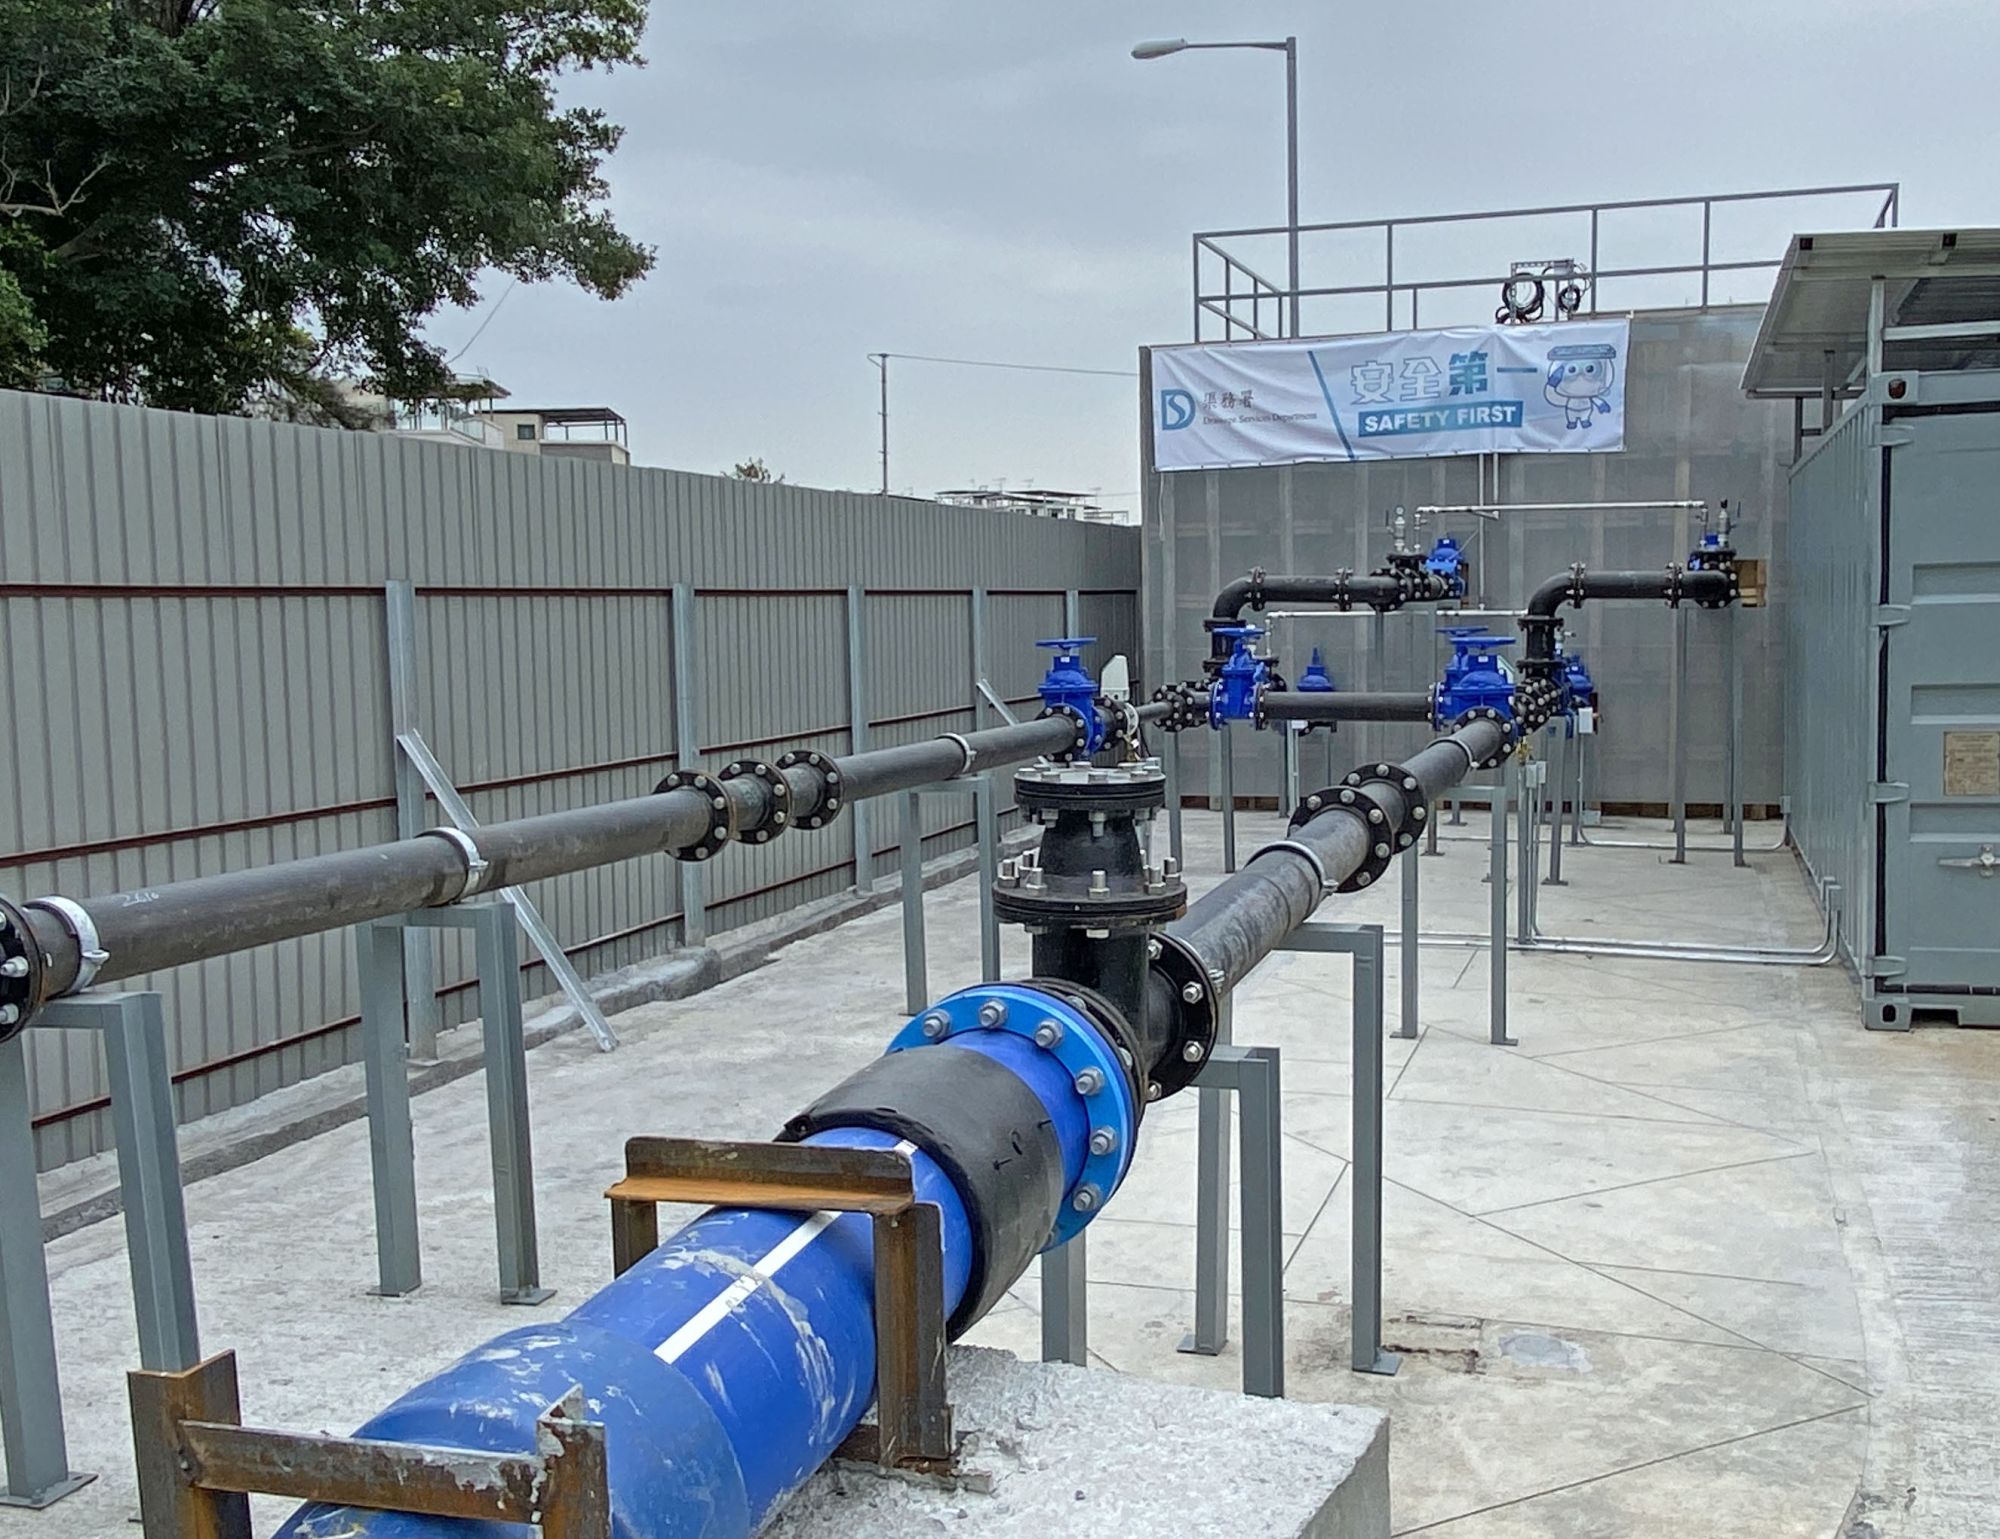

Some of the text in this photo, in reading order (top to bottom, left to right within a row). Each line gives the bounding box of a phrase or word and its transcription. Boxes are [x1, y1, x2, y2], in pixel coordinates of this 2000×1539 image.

[1351, 351, 1538, 405] 安全第一
[1365, 405, 1517, 432] SAFETY FIRST
